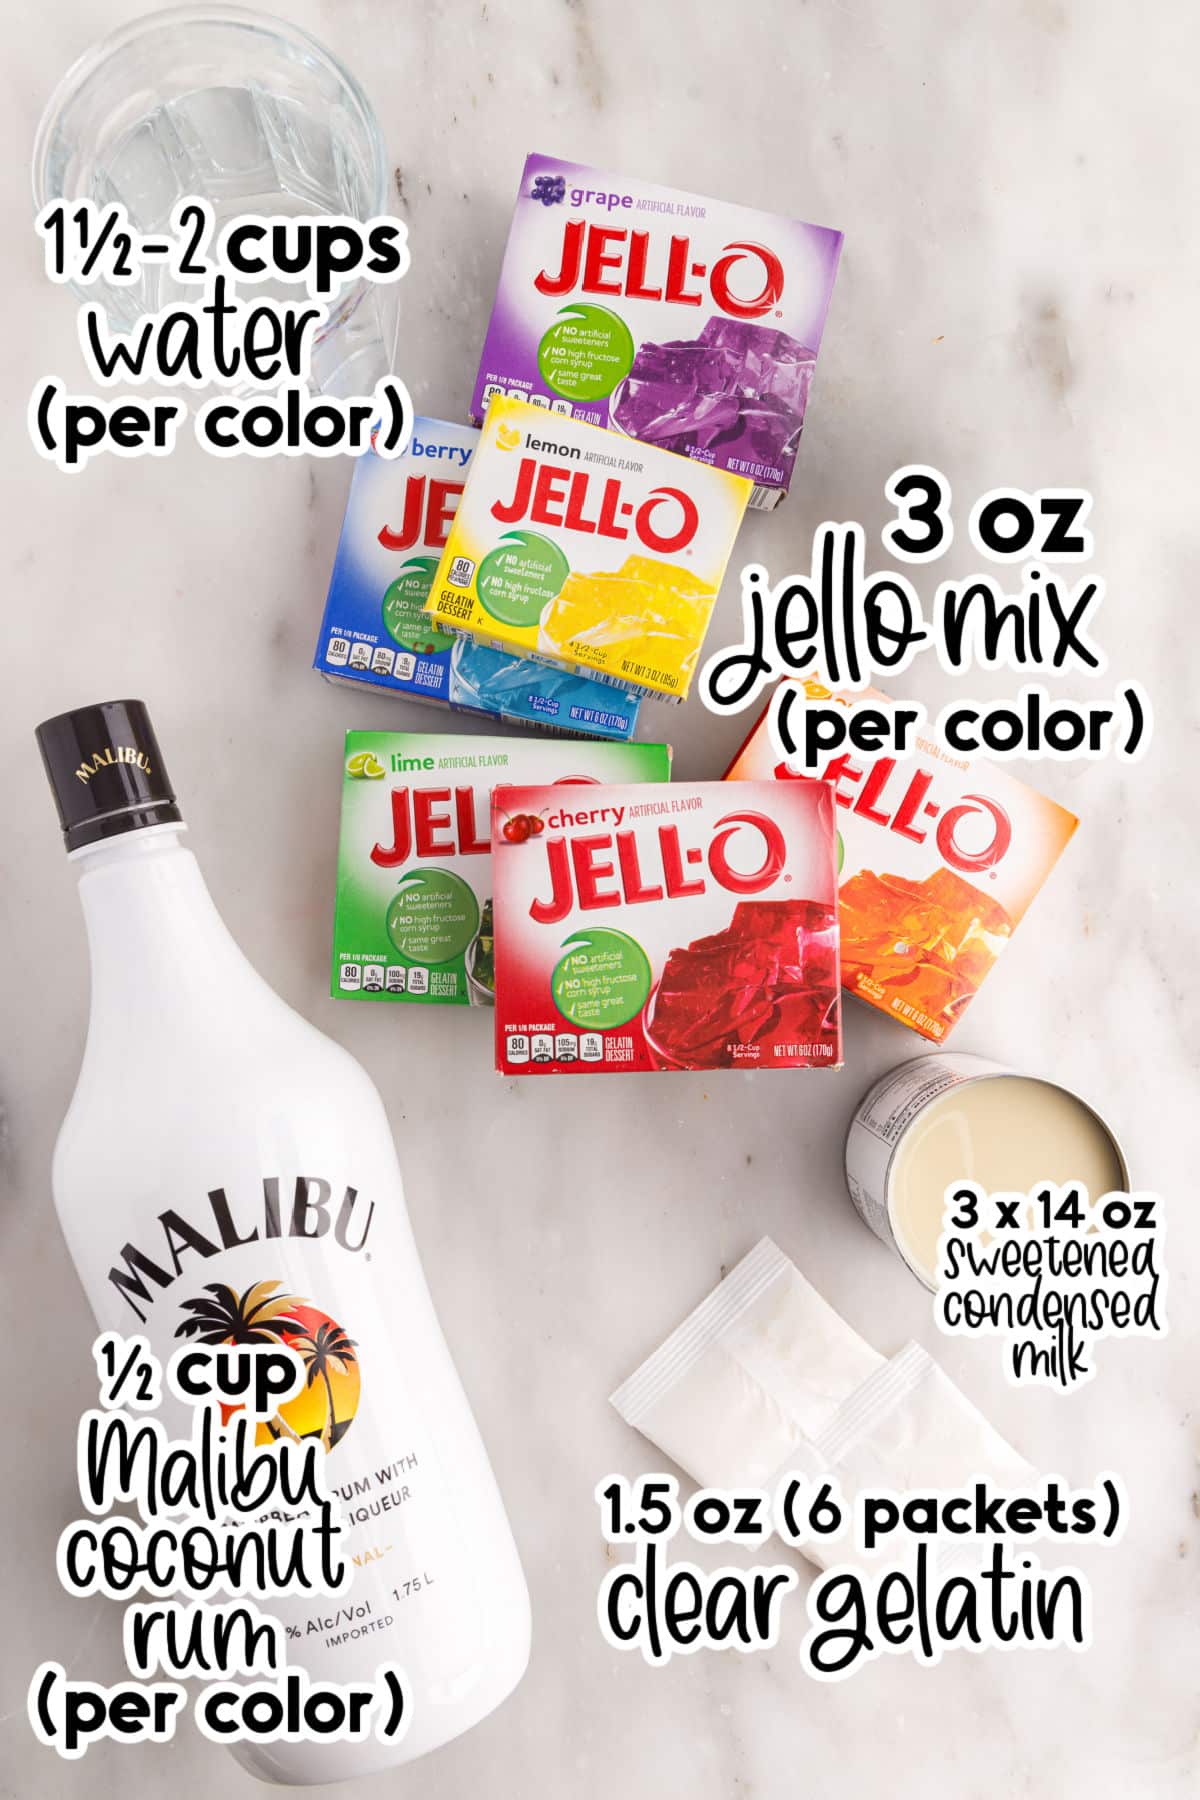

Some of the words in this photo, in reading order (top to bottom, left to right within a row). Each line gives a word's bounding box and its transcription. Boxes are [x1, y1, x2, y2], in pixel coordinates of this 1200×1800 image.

[571, 189, 633, 211] grape
[636, 200, 674, 214] ARTIFICIAL
[676, 205, 706, 218] FLAVOR
[563, 327, 577, 335] NO
[580, 329, 611, 339] artificial
[562, 337, 608, 347] sweeteners
[552, 347, 566, 356] NO
[568, 350, 585, 362] high
[587, 352, 620, 362] fructose
[550, 357, 568, 365] corn
[571, 360, 592, 368] syrup
[486, 373, 497, 382] PER
[557, 378, 577, 386] taste
[558, 370, 578, 378] same
[580, 372, 602, 382] great
[574, 409, 601, 425] GELATIN
[412, 438, 472, 467] berry
[526, 433, 581, 460] lemon
[584, 452, 617, 467] ARTIFICIAL
[618, 458, 644, 474] FLAVOR
[727, 458, 739, 470] NET
[740, 460, 749, 472] WT
[457, 560, 469, 572] 80
[506, 555, 517, 564] NO
[520, 560, 552, 572] artificial
[504, 566, 544, 580] sweeteners
[405, 580, 419, 588] NO
[491, 577, 502, 586] NO
[505, 580, 522, 592] high
[441, 590, 474, 609] GELATIN
[489, 588, 506, 597] corn
[509, 592, 528, 603] syrup
[396, 600, 408, 609] NO
[437, 601, 472, 621] DESSERT
[333, 641, 345, 652] 80
[418, 661, 444, 676] GELATIN
[622, 660, 633, 672] NET
[635, 664, 645, 675] WT
[646, 668, 651, 679] 3
[652, 669, 661, 681] OZ
[660, 672, 679, 688] (85g)
[415, 673, 443, 688] DESSERT
[533, 703, 557, 714] Servings
[571, 706, 583, 718] NET
[585, 708, 594, 720] WT
[600, 712, 608, 724] OZ
[609, 713, 628, 729] (170g)
[75, 746, 149, 784] MALIBU
[391, 754, 434, 772] lime
[438, 757, 477, 769] ARTIFICIAL
[479, 755, 508, 766] FLAVOR
[548, 806, 625, 828] cherry
[629, 800, 670, 819] ARTIFICIAL
[671, 797, 703, 816] FLAVOR
[775, 752, 1011, 872] ELL-O
[370, 785, 491, 868] JEL
[422, 893, 452, 901] artificial
[414, 915, 431, 924] high
[433, 914, 465, 922] fructose
[419, 924, 440, 934] syrup
[571, 955, 588, 964] NO
[590, 951, 623, 962] artificial
[345, 967, 357, 977] 80
[572, 963, 621, 974] sweeteners
[431, 973, 456, 985] GELATIN
[565, 980, 580, 990] NO
[583, 978, 601, 988] high
[603, 974, 637, 984] fructose
[431, 985, 456, 996] DESSERT
[567, 990, 586, 998] corn
[589, 986, 611, 997] syrup
[577, 1001, 600, 1010] same
[601, 997, 623, 1008] great
[578, 1008, 600, 1017] taste
[512, 1038, 523, 1049] 80
[606, 1037, 632, 1049] GELATIN
[606, 1050, 633, 1061] DESSERT
[733, 1051, 760, 1059] Servings
[774, 1045, 785, 1056] NET
[788, 1045, 797, 1056] WT
[813, 1044, 832, 1056] (170g)
[108, 1176, 375, 1324] MALIBU
[375, 1453, 418, 1485] WITH
[349, 1486, 412, 1525] IQUEUR
[306, 1601, 371, 1635] Alc/Vol
[393, 1577, 421, 1601] 1.75
[424, 1573, 434, 1583] L
[326, 1616, 393, 1648] IMPORTED
